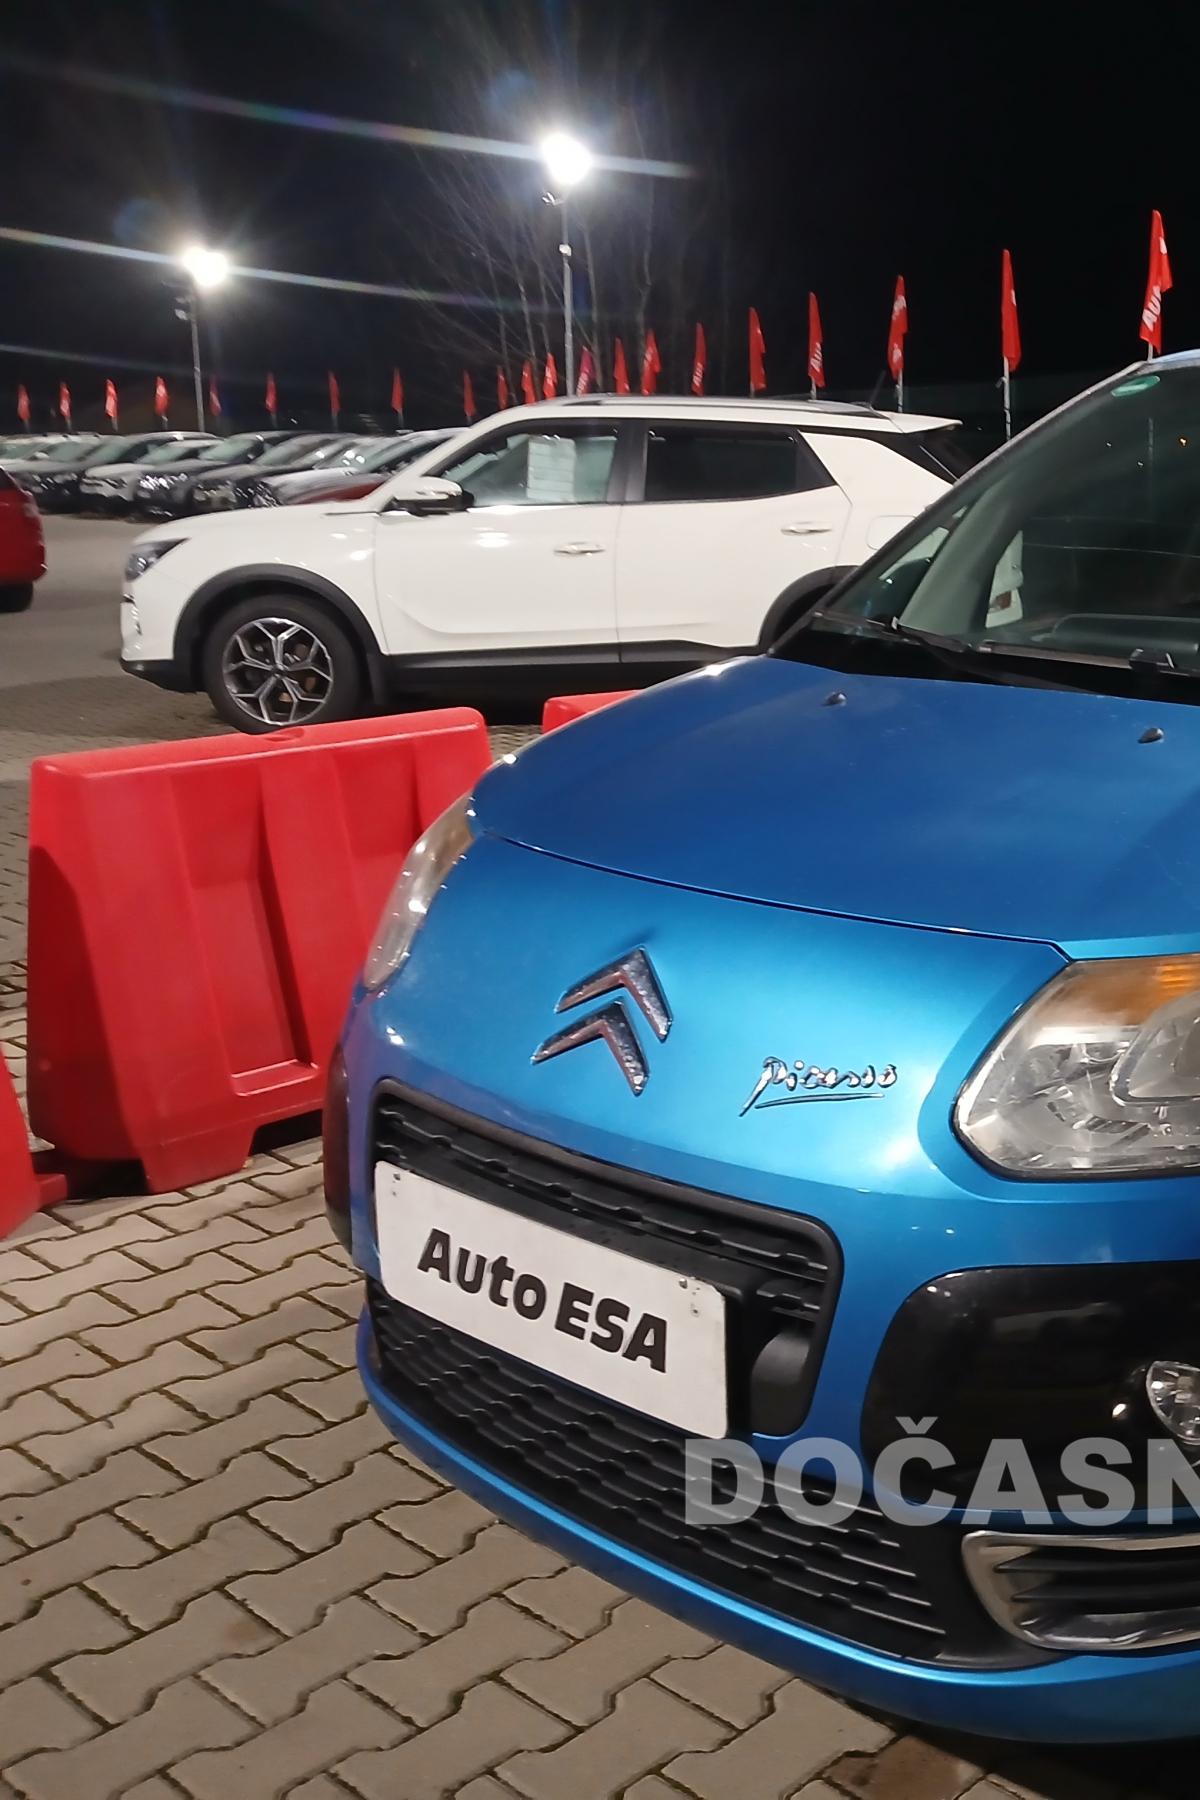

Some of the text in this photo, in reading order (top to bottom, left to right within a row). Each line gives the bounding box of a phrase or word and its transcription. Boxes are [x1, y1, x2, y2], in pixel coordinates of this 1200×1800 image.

[739, 1056, 898, 1117] Picasso
[417, 1228, 667, 1373] Auto ESA
